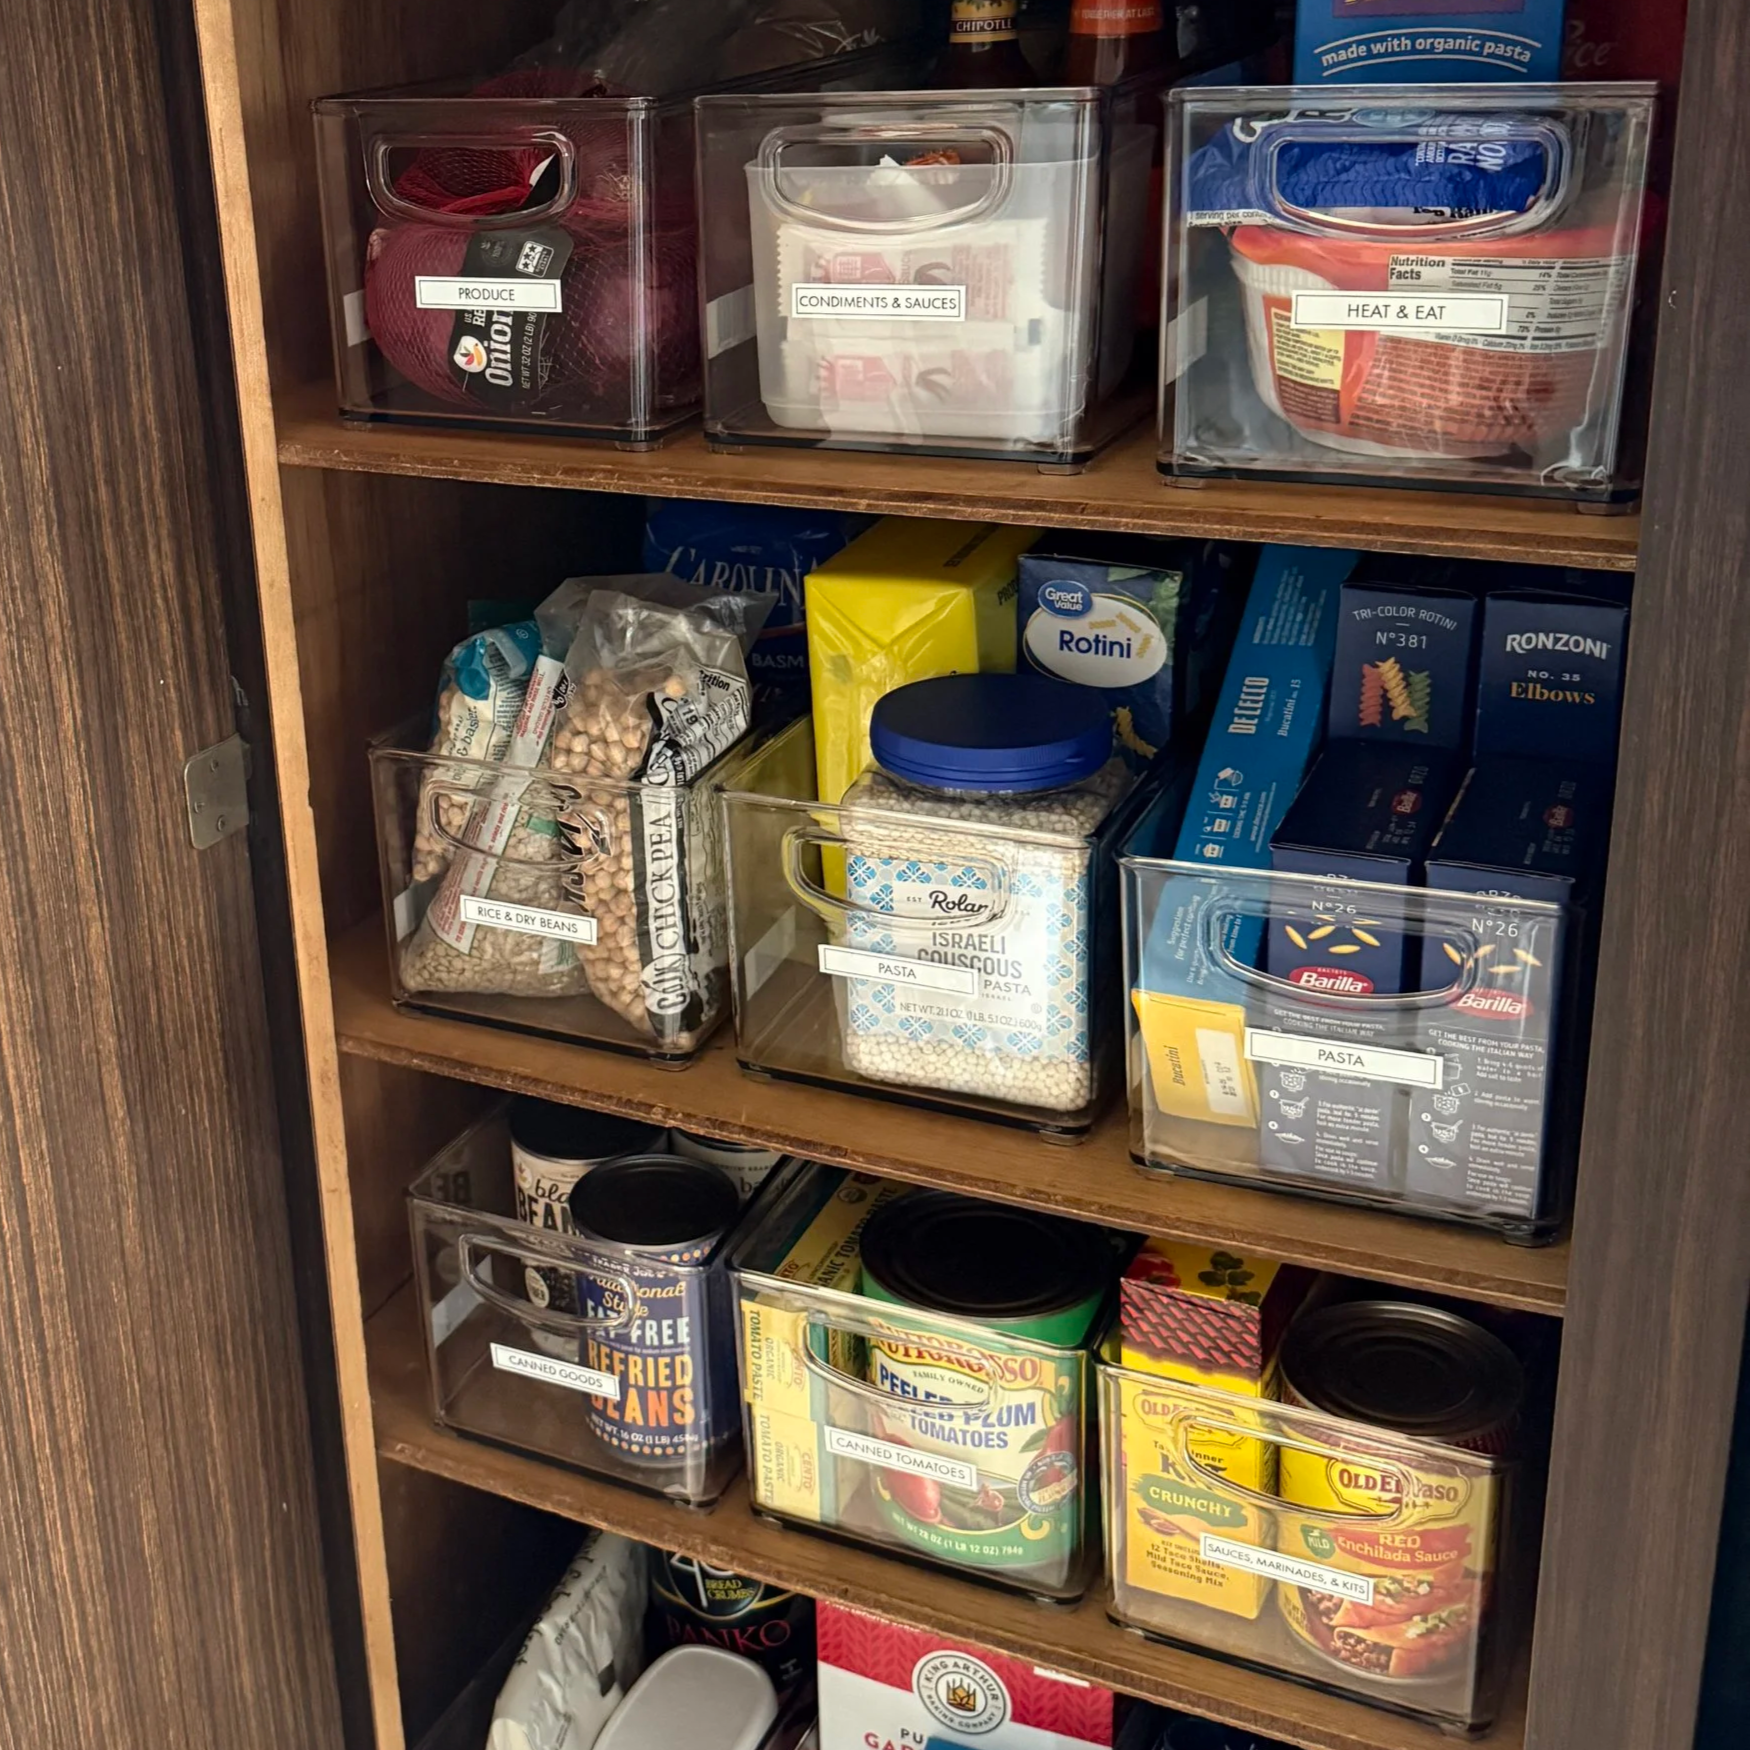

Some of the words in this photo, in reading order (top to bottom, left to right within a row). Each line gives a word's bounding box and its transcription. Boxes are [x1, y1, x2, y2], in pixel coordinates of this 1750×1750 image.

[1321, 43, 1367, 67] made
[1370, 36, 1412, 56] with
[1414, 35, 1480, 53] organic
[1483, 40, 1532, 63] pasta
[1390, 256, 1445, 268] Nutrition
[1390, 267, 1421, 280] Facts
[458, 287, 515, 301] PRODUCE
[799, 296, 888, 309] CONDIMENTS
[891, 297, 901, 309] &
[904, 297, 957, 310] SAUCES
[1347, 303, 1390, 319] HEAT
[1396, 305, 1409, 320] &
[1415, 305, 1447, 320] EAT
[523, 344, 533, 356] OZ
[525, 356, 532, 366] 32
[664, 546, 819, 607] CAROLIN
[1045, 587, 1083, 604] Great
[1053, 600, 1083, 612] Value
[1352, 606, 1416, 621] TRI-COLOR
[1418, 608, 1459, 631] ROTINI
[1058, 630, 1132, 659] Rotini
[1375, 631, 1428, 650] N°381
[1505, 632, 1609, 660] RONZONI
[752, 653, 804, 669] BASM
[1528, 670, 1555, 680] NO.
[1561, 673, 1581, 682] 35
[1510, 681, 1596, 706] Elbows
[1277, 699, 1296, 737] Bucatini
[652, 867, 680, 951] CHICK
[1311, 900, 1357, 915] N°26
[477, 906, 502, 921] RICE
[504, 911, 513, 922] &
[515, 913, 537, 926] DRY
[540, 917, 579, 934] BEANS
[1167, 906, 1184, 945] Suggestion
[1471, 918, 1519, 938] N°26
[932, 931, 1006, 955] ISRAELI
[1178, 923, 1192, 949] perfect
[917, 949, 1023, 979] COUSCOUS
[1174, 949, 1185, 960] for
[878, 963, 917, 980] PASTA
[1298, 971, 1368, 994] Barilla
[984, 979, 1032, 997] PASTA
[900, 1002, 918, 1013] NET
[1457, 993, 1526, 1016] Barilla
[1283, 1017, 1314, 1030] COOKING
[1314, 1022, 1330, 1033] THE
[1428, 1028, 1443, 1039] GET
[1443, 1031, 1458, 1041] THE
[1458, 1034, 1477, 1044] BEST
[1477, 1037, 1499, 1047] FROM
[1499, 1040, 1520, 1049] YOUR
[1437, 1038, 1470, 1051] COOKING
[1471, 1043, 1486, 1053] THE
[1487, 1046, 1517, 1058] ITALIAN
[1517, 1050, 1535, 1060] WAY
[1163, 1044, 1186, 1087] Bucatini
[1318, 1049, 1365, 1067] PASTA
[630, 1316, 691, 1346] FREE
[749, 1309, 762, 1360] TOMATO
[587, 1338, 694, 1389] REFRIED
[765, 1336, 775, 1380] ORGANIC
[508, 1354, 557, 1376] CANNED
[558, 1367, 603, 1389] GOODS
[751, 1361, 764, 1402] PASTE
[912, 1369, 946, 1383] FAMILY
[949, 1378, 985, 1394] OWNED
[630, 1433, 644, 1442] OZ
[655, 1434, 671, 1445] LB)
[759, 1414, 773, 1463] TOMATO
[910, 1414, 1009, 1450] TOMATOES
[774, 1441, 786, 1484] ORGANIC
[836, 1436, 893, 1460] CANNED
[895, 1451, 966, 1480] TOMATOES
[802, 1452, 813, 1490] CENTO
[1339, 1467, 1378, 1491] OLD
[763, 1464, 774, 1506] PASTE
[1149, 1486, 1232, 1518] CRUNCHY
[930, 1533, 943, 1545] OZ
[970, 1543, 980, 1553] 12
[983, 1543, 999, 1556] OZ)
[1308, 1536, 1330, 1550] MILD
[1337, 1536, 1411, 1563] Enchilada
[1414, 1549, 1458, 1563] Sauce
[1379, 1533, 1421, 1547] RED
[1146, 1549, 1168, 1564] Mild
[1170, 1555, 1192, 1571] Taco
[1164, 1545, 1186, 1560] Taco
[1151, 1560, 1203, 1583] Seasoning
[1205, 1575, 1224, 1588] Mix
[1207, 1543, 1254, 1565] SAUCES,
[1256, 1556, 1327, 1585] MARINADES,
[1329, 1575, 1340, 1587] &
[1342, 1579, 1366, 1595] KITS
[705, 1578, 742, 1589] BREAD
[707, 1587, 755, 1600] CRUMBS
[666, 1613, 791, 1653] PANKO
[923, 1660, 949, 1683] KING
[951, 1661, 1000, 1702] ARTHUR
[926, 1693, 956, 1725] BAKING
[957, 1711, 997, 1730] COMPANY
